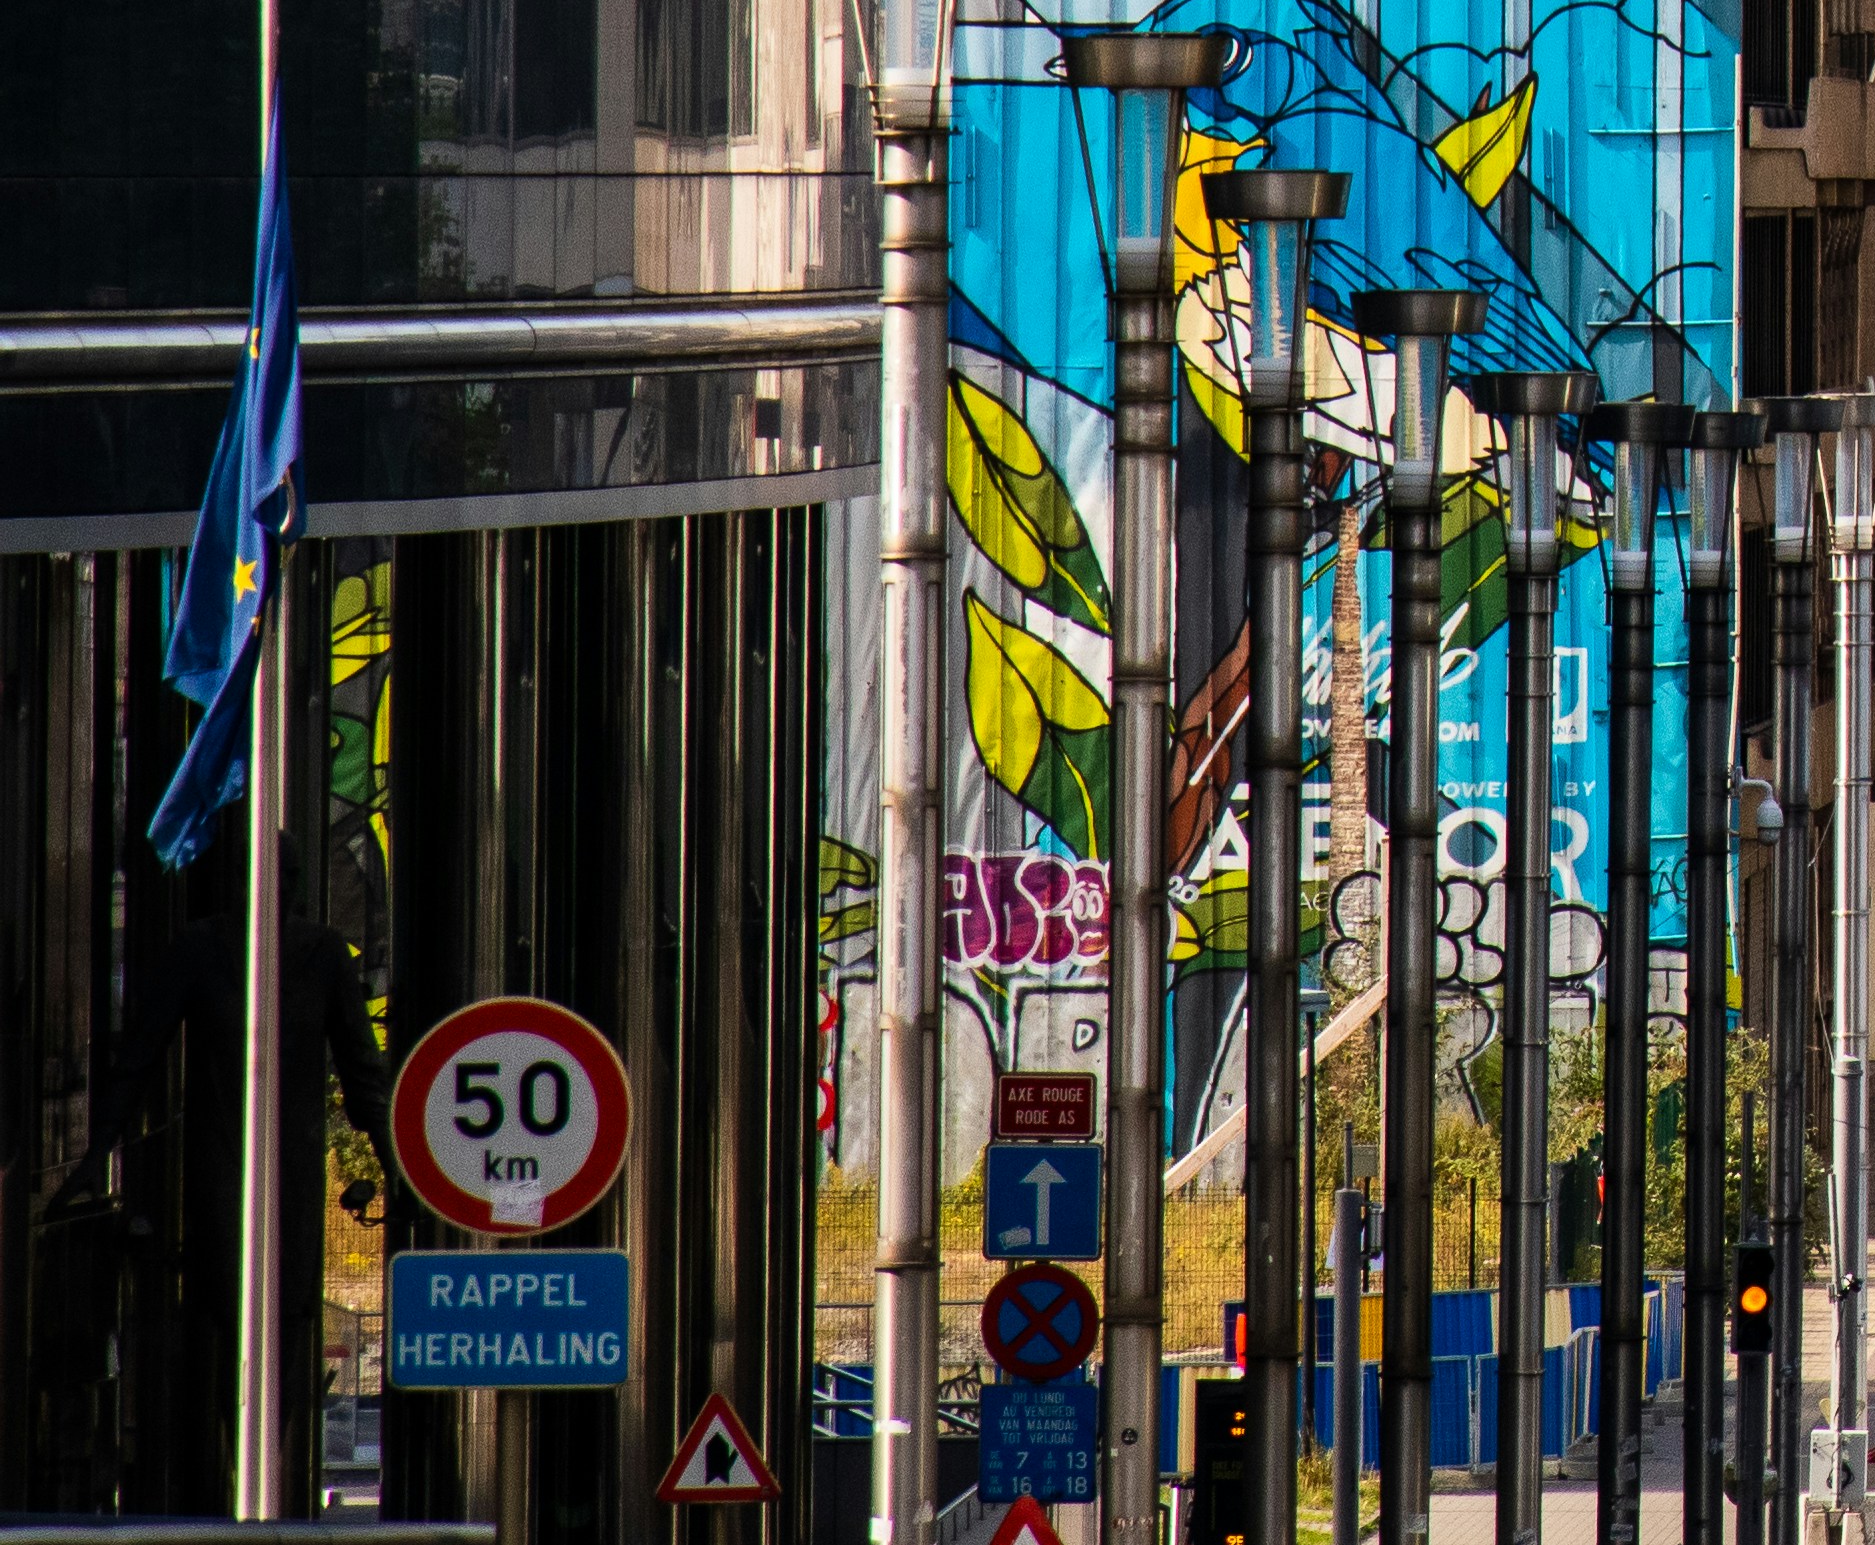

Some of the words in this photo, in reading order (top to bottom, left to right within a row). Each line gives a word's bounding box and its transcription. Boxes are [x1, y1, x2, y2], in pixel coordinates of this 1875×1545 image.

[1564, 780, 1596, 797] BY
[453, 1061, 571, 1140] 50
[1008, 1087, 1034, 1102] AXE
[1042, 1087, 1084, 1103] ROUGE
[1015, 1109, 1049, 1125] RODE
[1058, 1109, 1075, 1125] AS
[484, 1150, 539, 1183] km
[430, 1273, 587, 1308] RAPPEL
[398, 1332, 621, 1367] HERHALING
[1034, 1392, 1065, 1404] LUNDI
[1003, 1406, 1016, 1417] AU
[1024, 1406, 1075, 1417] VENDREDI
[1000, 1419, 1020, 1431] VAN
[1027, 1419, 1078, 1431] MAANDAG
[1003, 1432, 1021, 1444] TOT
[1029, 1433, 1074, 1444] VRIJDAG
[1017, 1451, 1029, 1469] 7
[1067, 1451, 1088, 1469] 13
[1012, 1476, 1032, 1494] 16
[1067, 1476, 1088, 1494] 18
